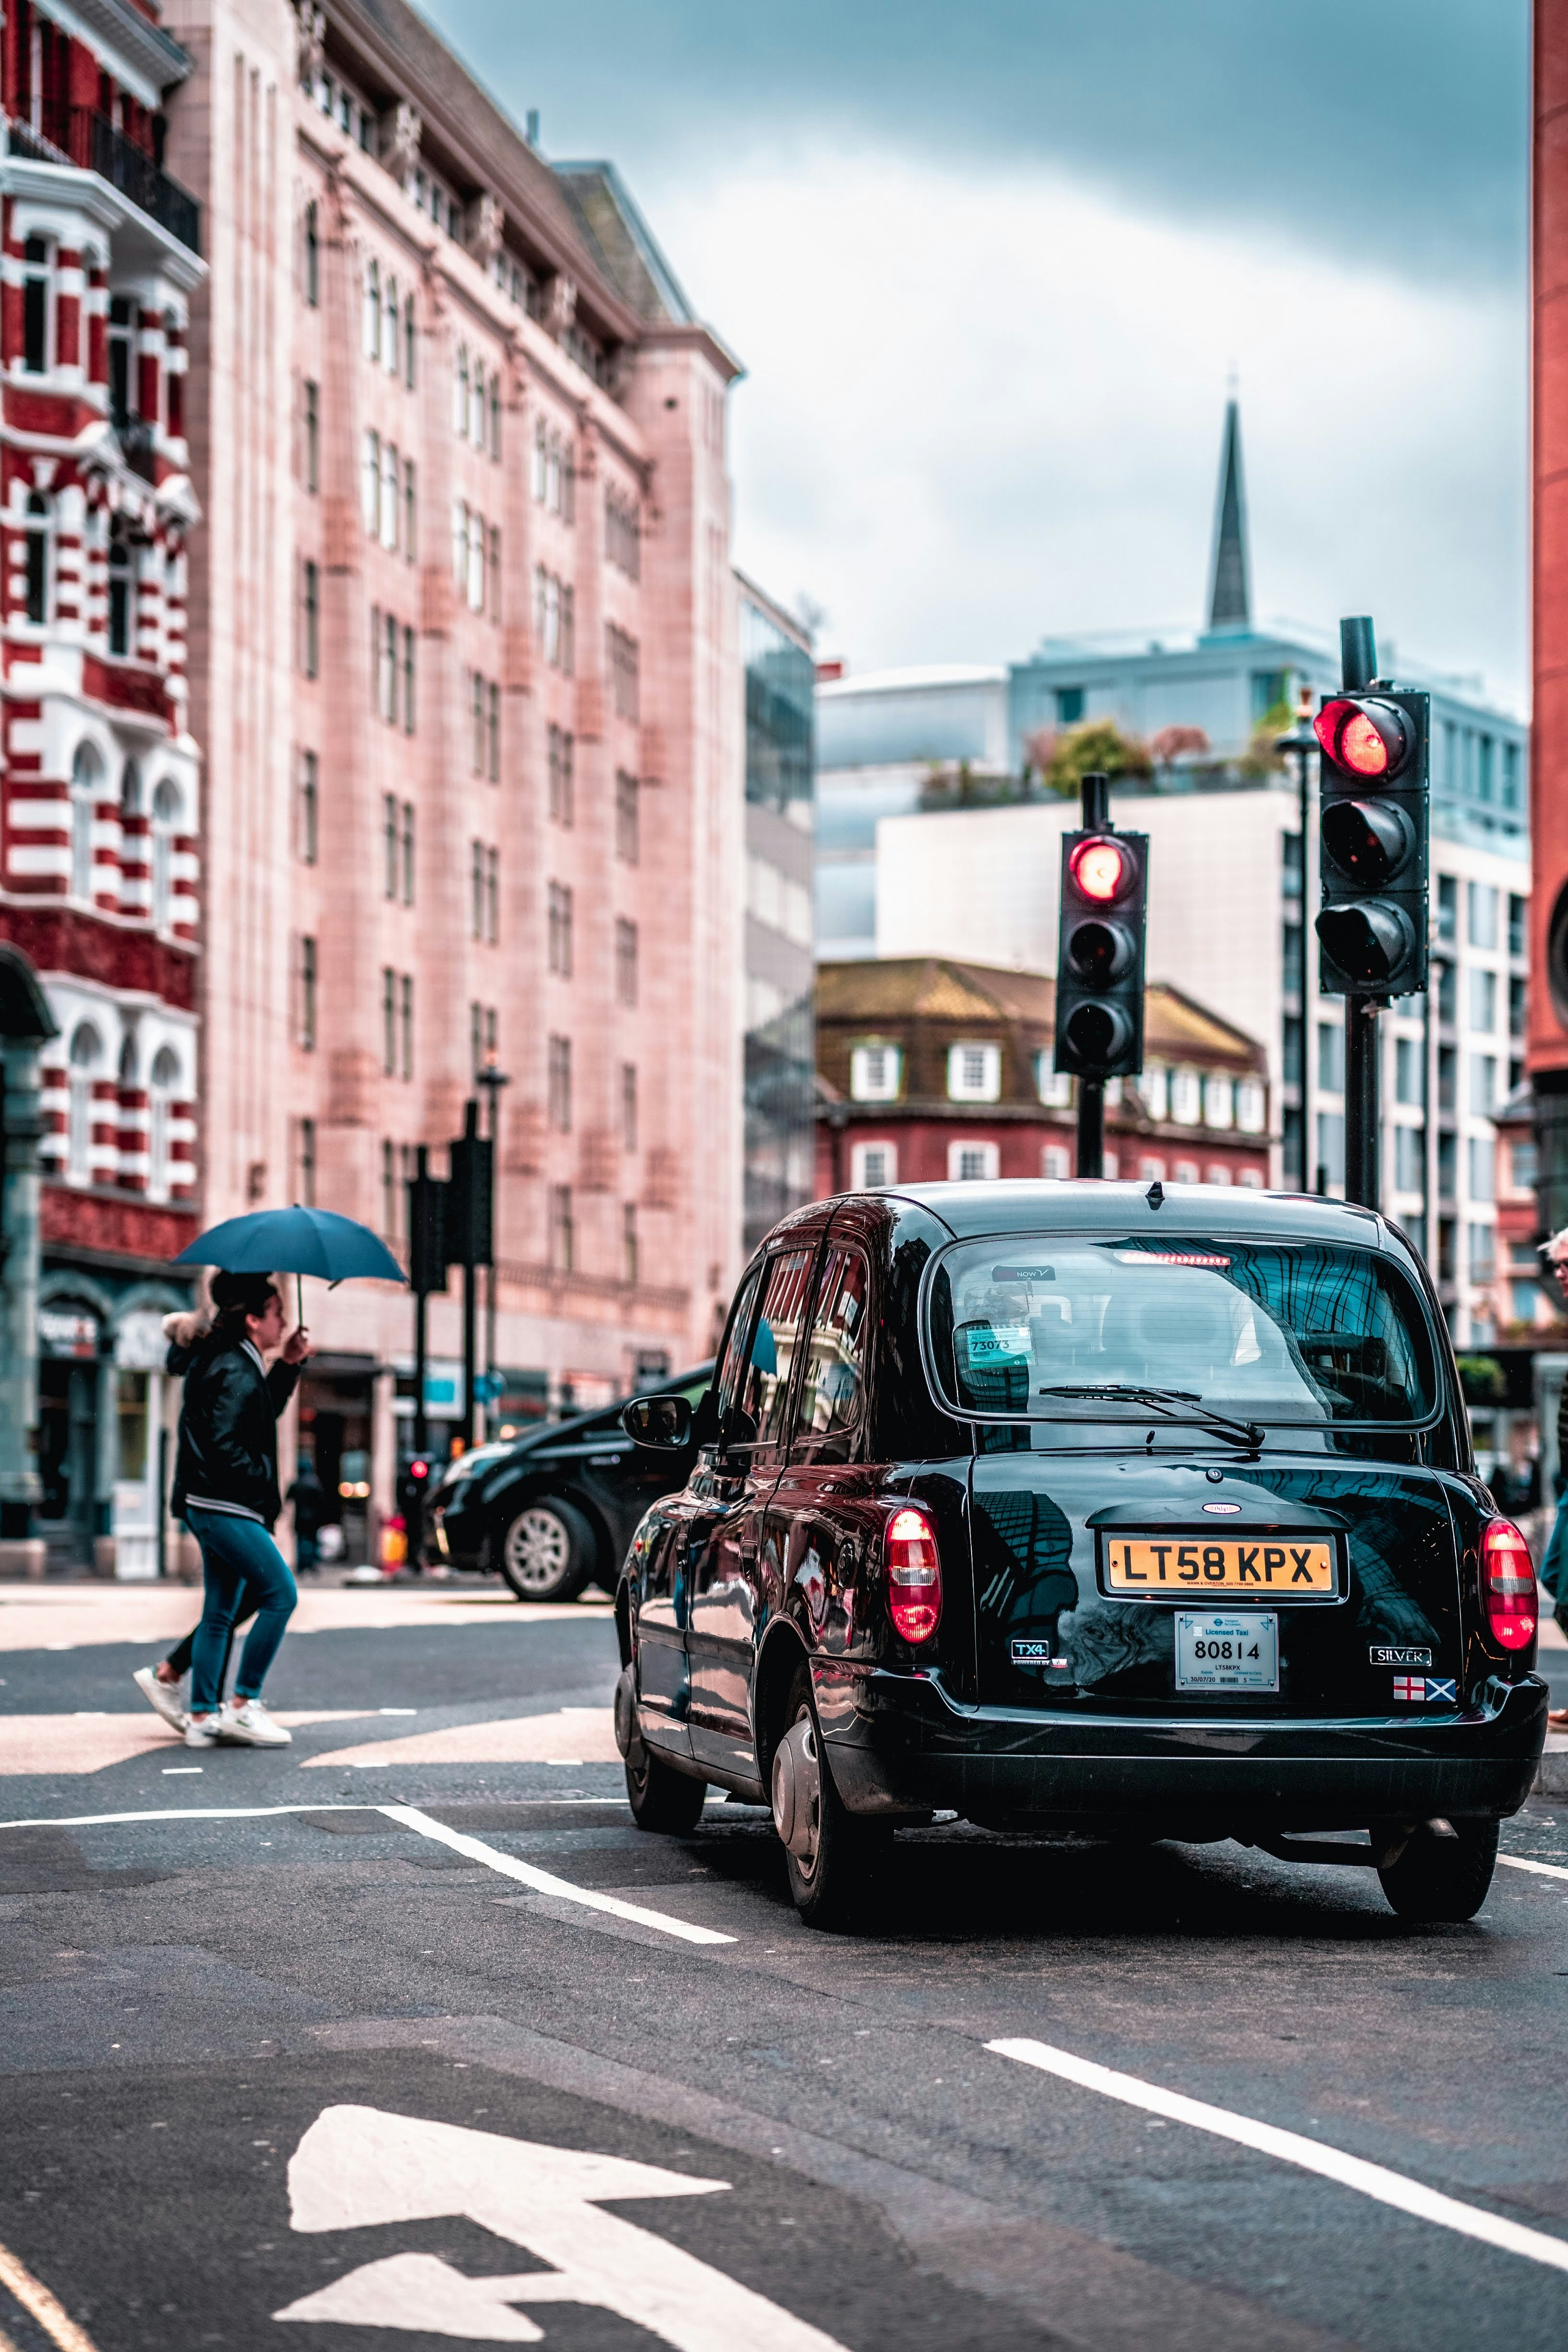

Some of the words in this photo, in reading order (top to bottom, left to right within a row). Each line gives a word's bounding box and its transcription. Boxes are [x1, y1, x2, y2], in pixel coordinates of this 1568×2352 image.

[972, 1340, 1010, 1351] 73073
[1123, 1545, 1225, 1581] LT58
[1238, 1547, 1313, 1583] KPX
[1015, 1644, 1046, 1655] TX4
[1194, 1641, 1260, 1660] 80814
[1377, 1650, 1423, 1662] SILVER
